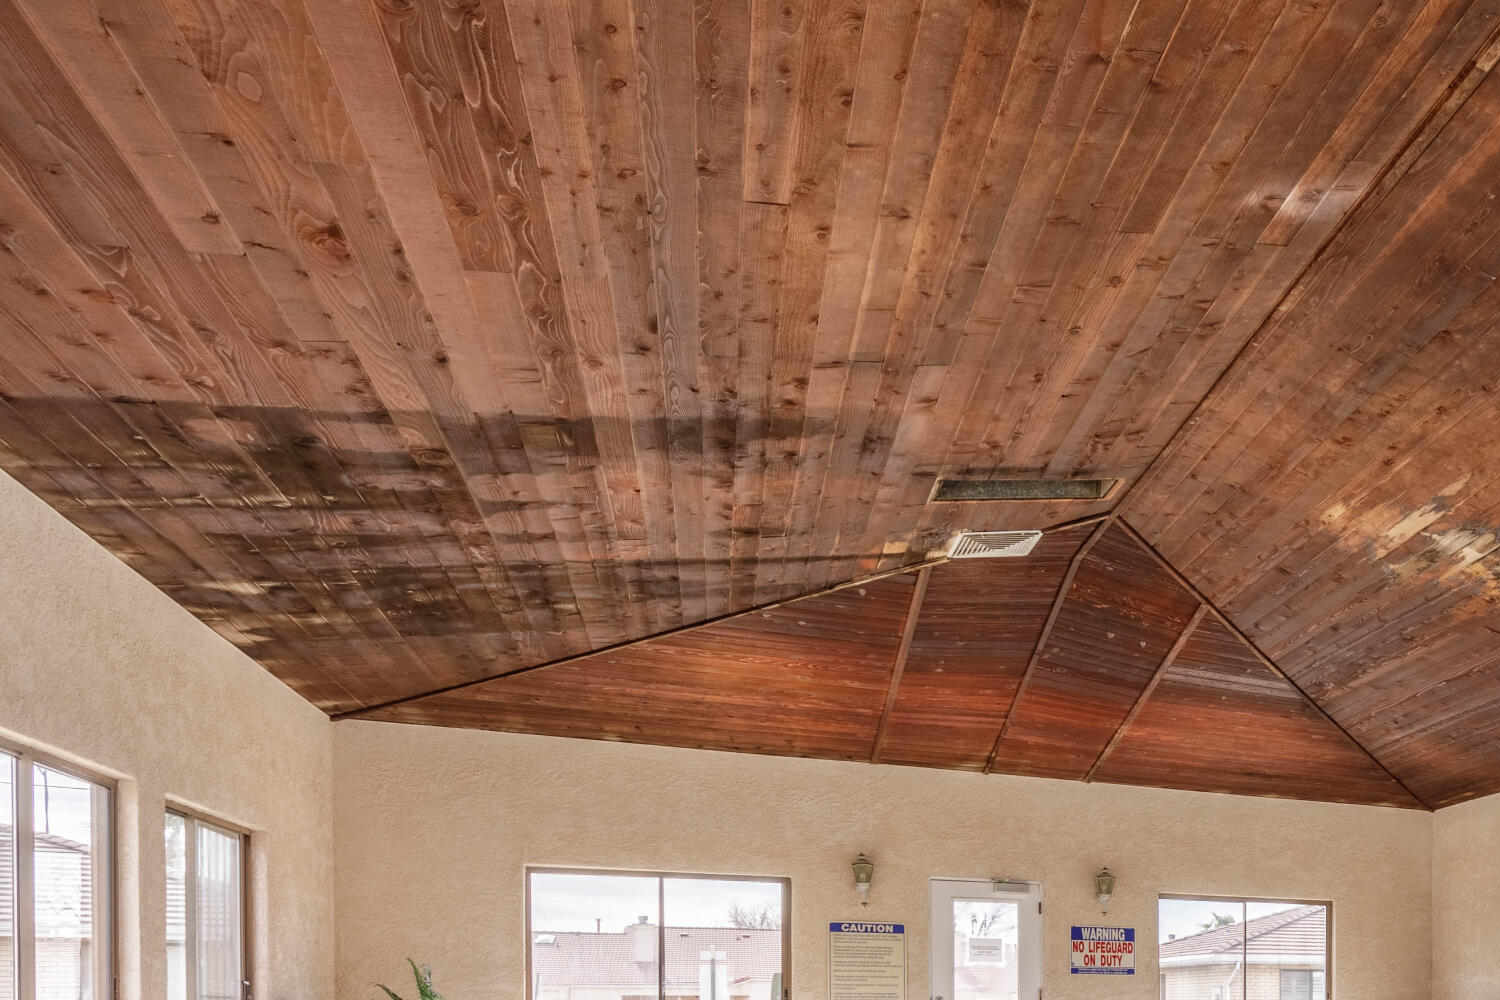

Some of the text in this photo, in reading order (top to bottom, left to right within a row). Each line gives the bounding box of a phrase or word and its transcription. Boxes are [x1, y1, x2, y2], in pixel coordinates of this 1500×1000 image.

[841, 923, 894, 933] CAUTION
[1081, 927, 1126, 941] WARNING
[1072, 941, 1134, 954] NO LIFEGUARD
[1083, 954, 1123, 967] ON DUTY
